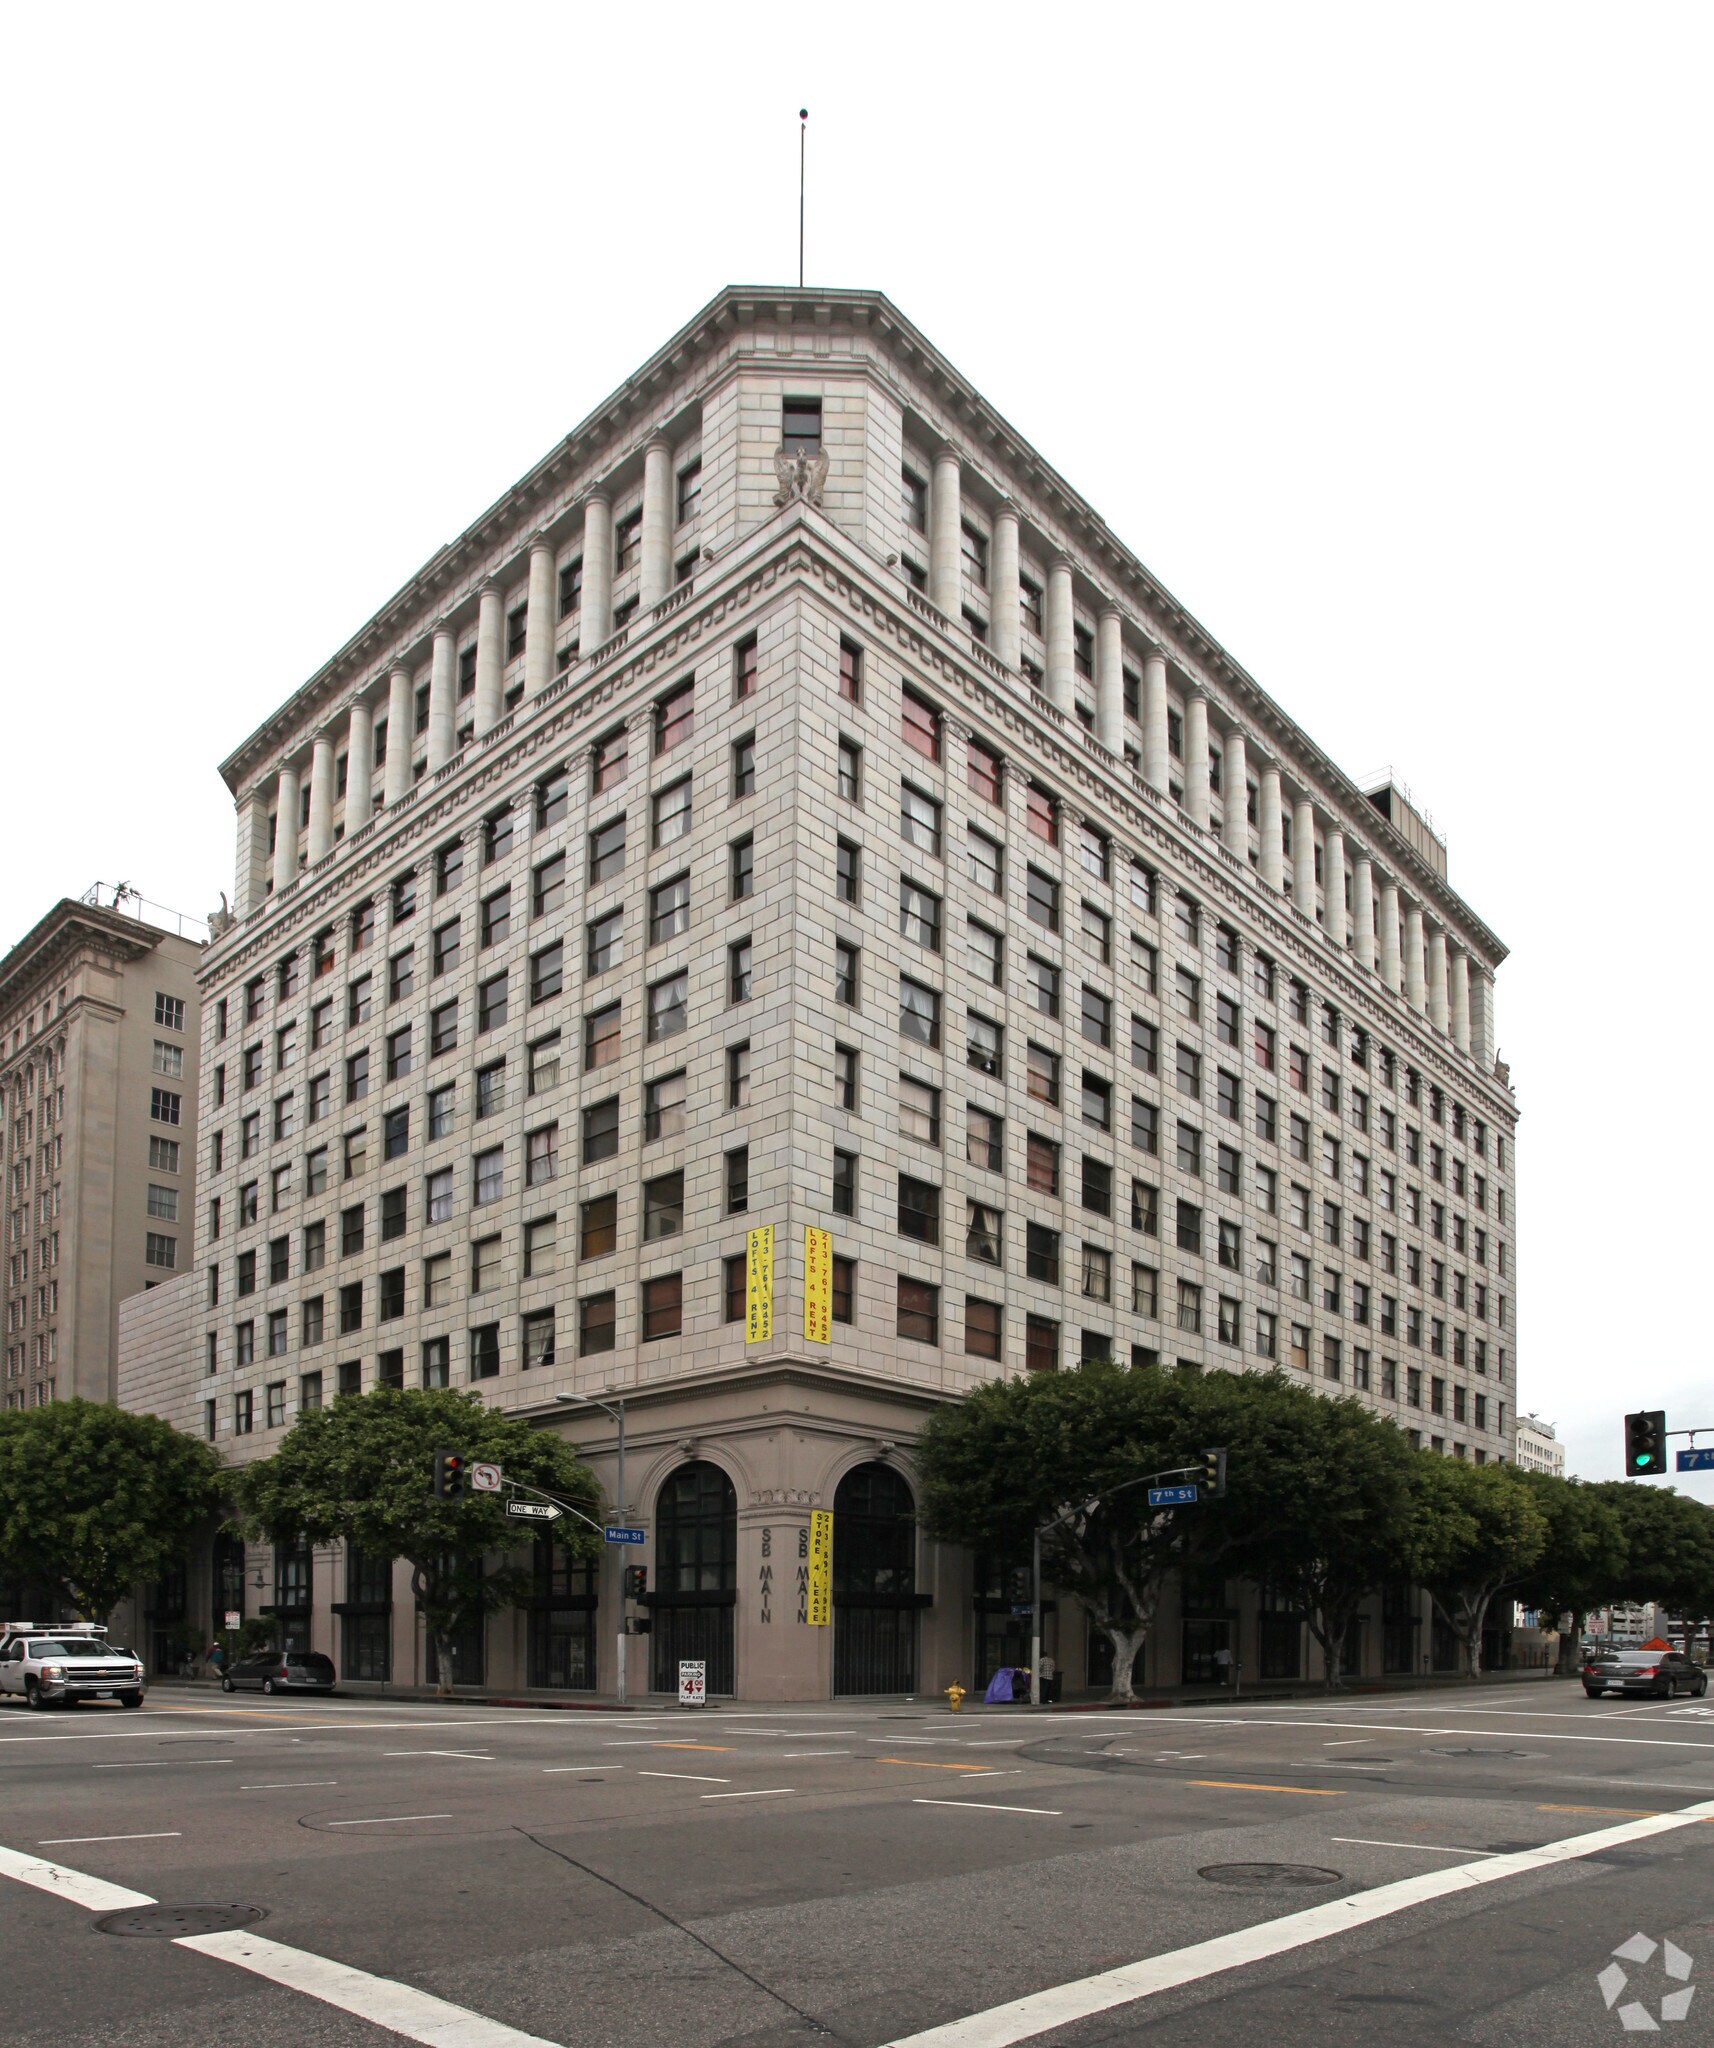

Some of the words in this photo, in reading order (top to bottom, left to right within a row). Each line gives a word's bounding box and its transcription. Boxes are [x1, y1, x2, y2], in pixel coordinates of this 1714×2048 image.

[762, 1228, 770, 1338] 213-761-9452
[750, 1304, 758, 1339] RENT
[511, 1504, 527, 1513] ONE
[532, 1507, 549, 1515] WAY
[1153, 1491, 1174, 1502] 7th
[1178, 1490, 1192, 1499] St
[609, 1530, 629, 1540] Main
[631, 1532, 642, 1541] St
[761, 1528, 772, 1558] SB
[798, 1529, 808, 1558] SB
[759, 1565, 773, 1624] MAIN
[796, 1566, 809, 1624] MAIN
